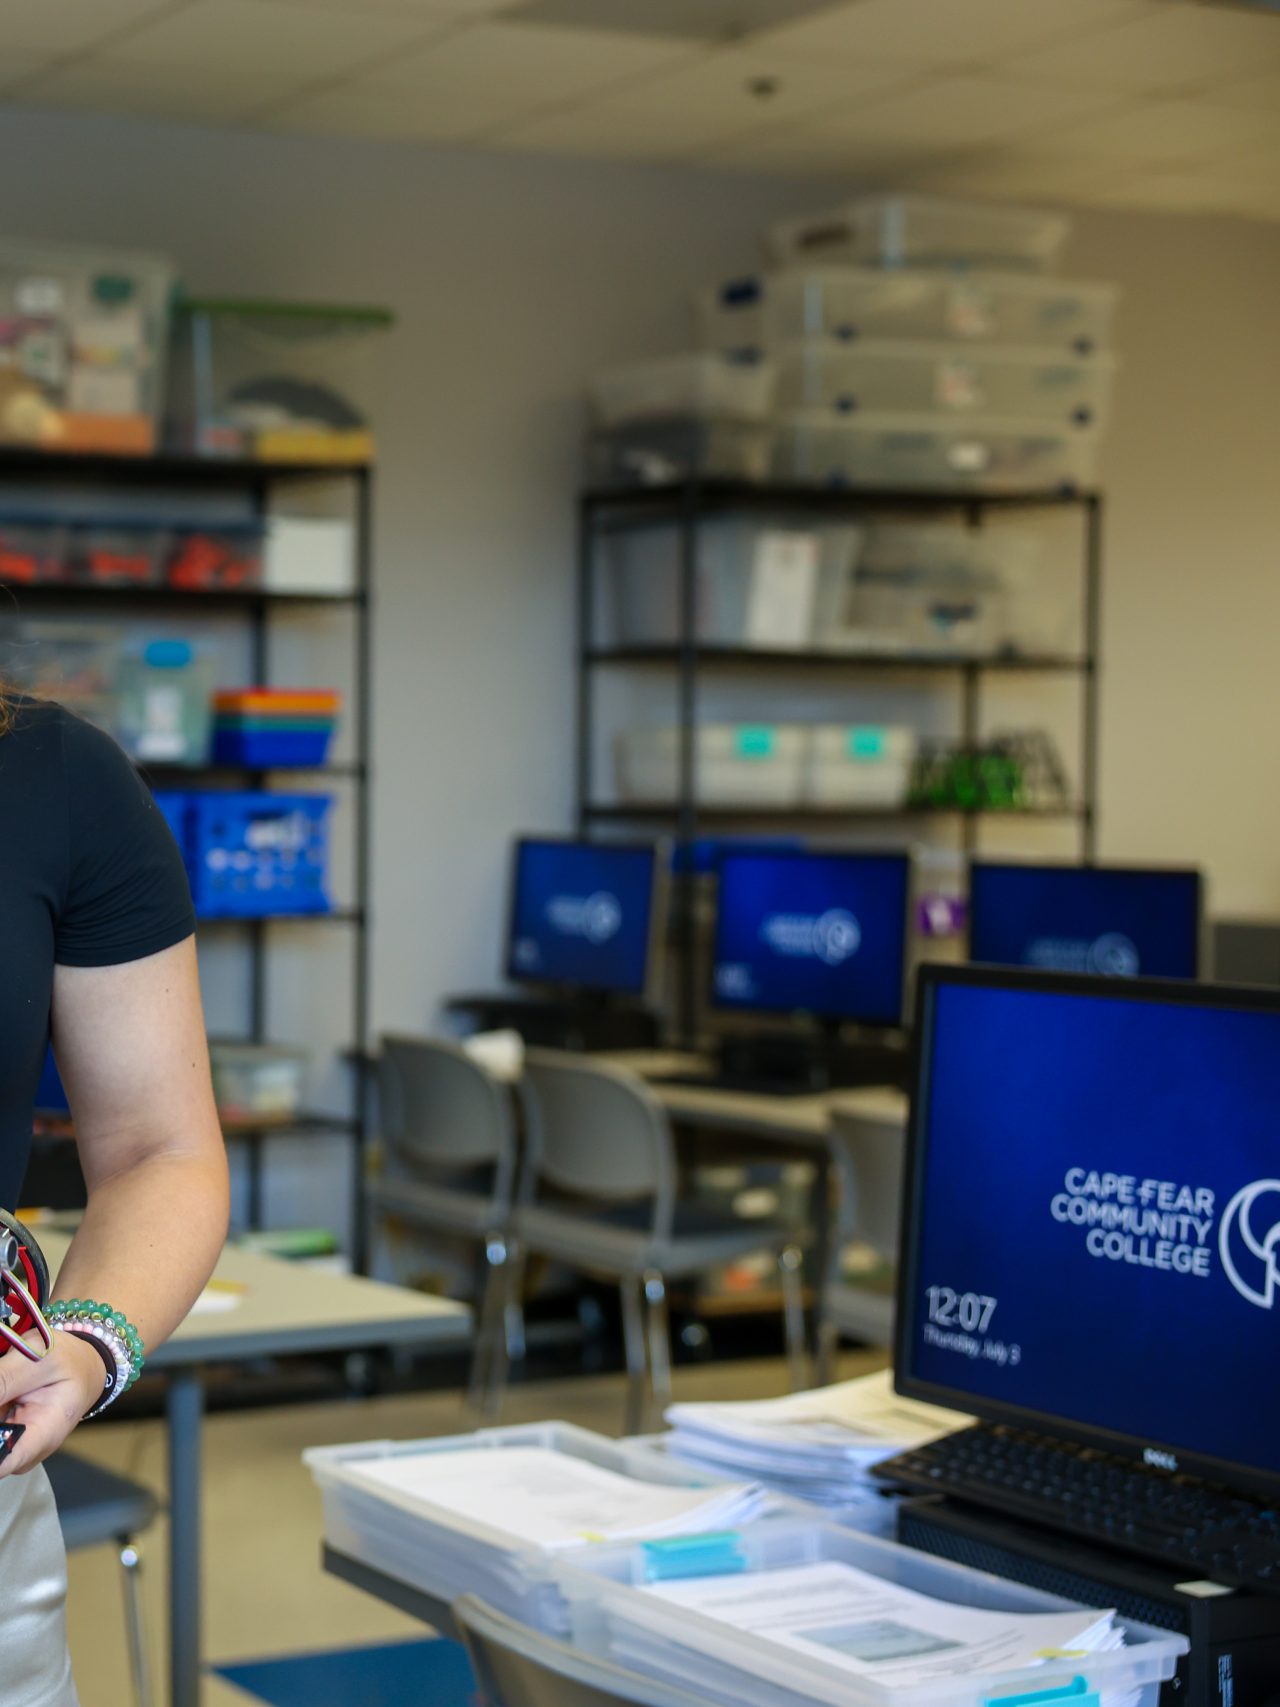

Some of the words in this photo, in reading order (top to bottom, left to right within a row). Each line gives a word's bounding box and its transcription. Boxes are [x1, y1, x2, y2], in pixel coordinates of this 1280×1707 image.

[1065, 1167, 1137, 1204] CAPE
[1137, 1178, 1216, 1218] FEAR
[1050, 1193, 1214, 1246] COMMUNITY
[1086, 1228, 1212, 1278] COLLEGE
[925, 1285, 998, 1333] 12:07
[1008, 1343, 1021, 1366] 3
